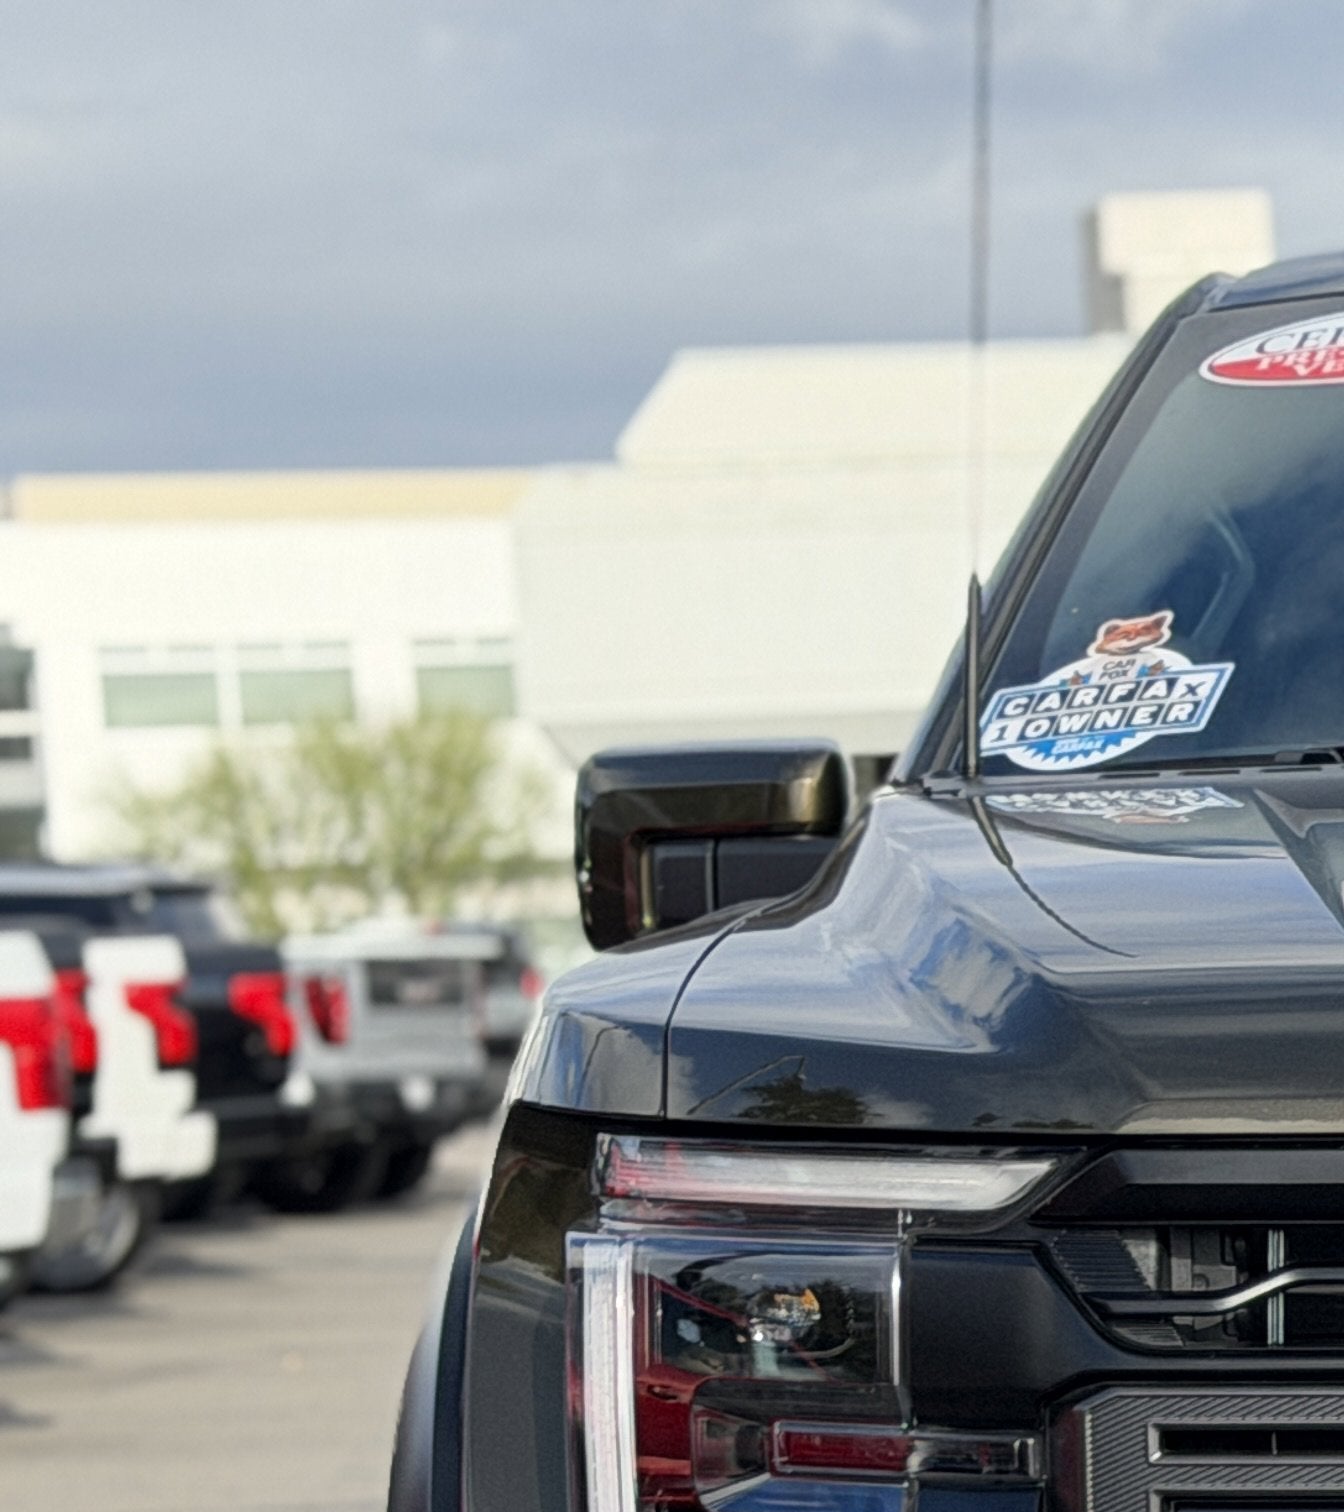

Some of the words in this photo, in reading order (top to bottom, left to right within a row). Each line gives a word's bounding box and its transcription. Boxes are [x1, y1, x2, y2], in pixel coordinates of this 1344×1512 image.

[1102, 659, 1137, 671] CAR
[1003, 680, 1206, 717] CARFAX
[989, 726, 1011, 743] 1
[1023, 701, 1194, 739] OWNER
